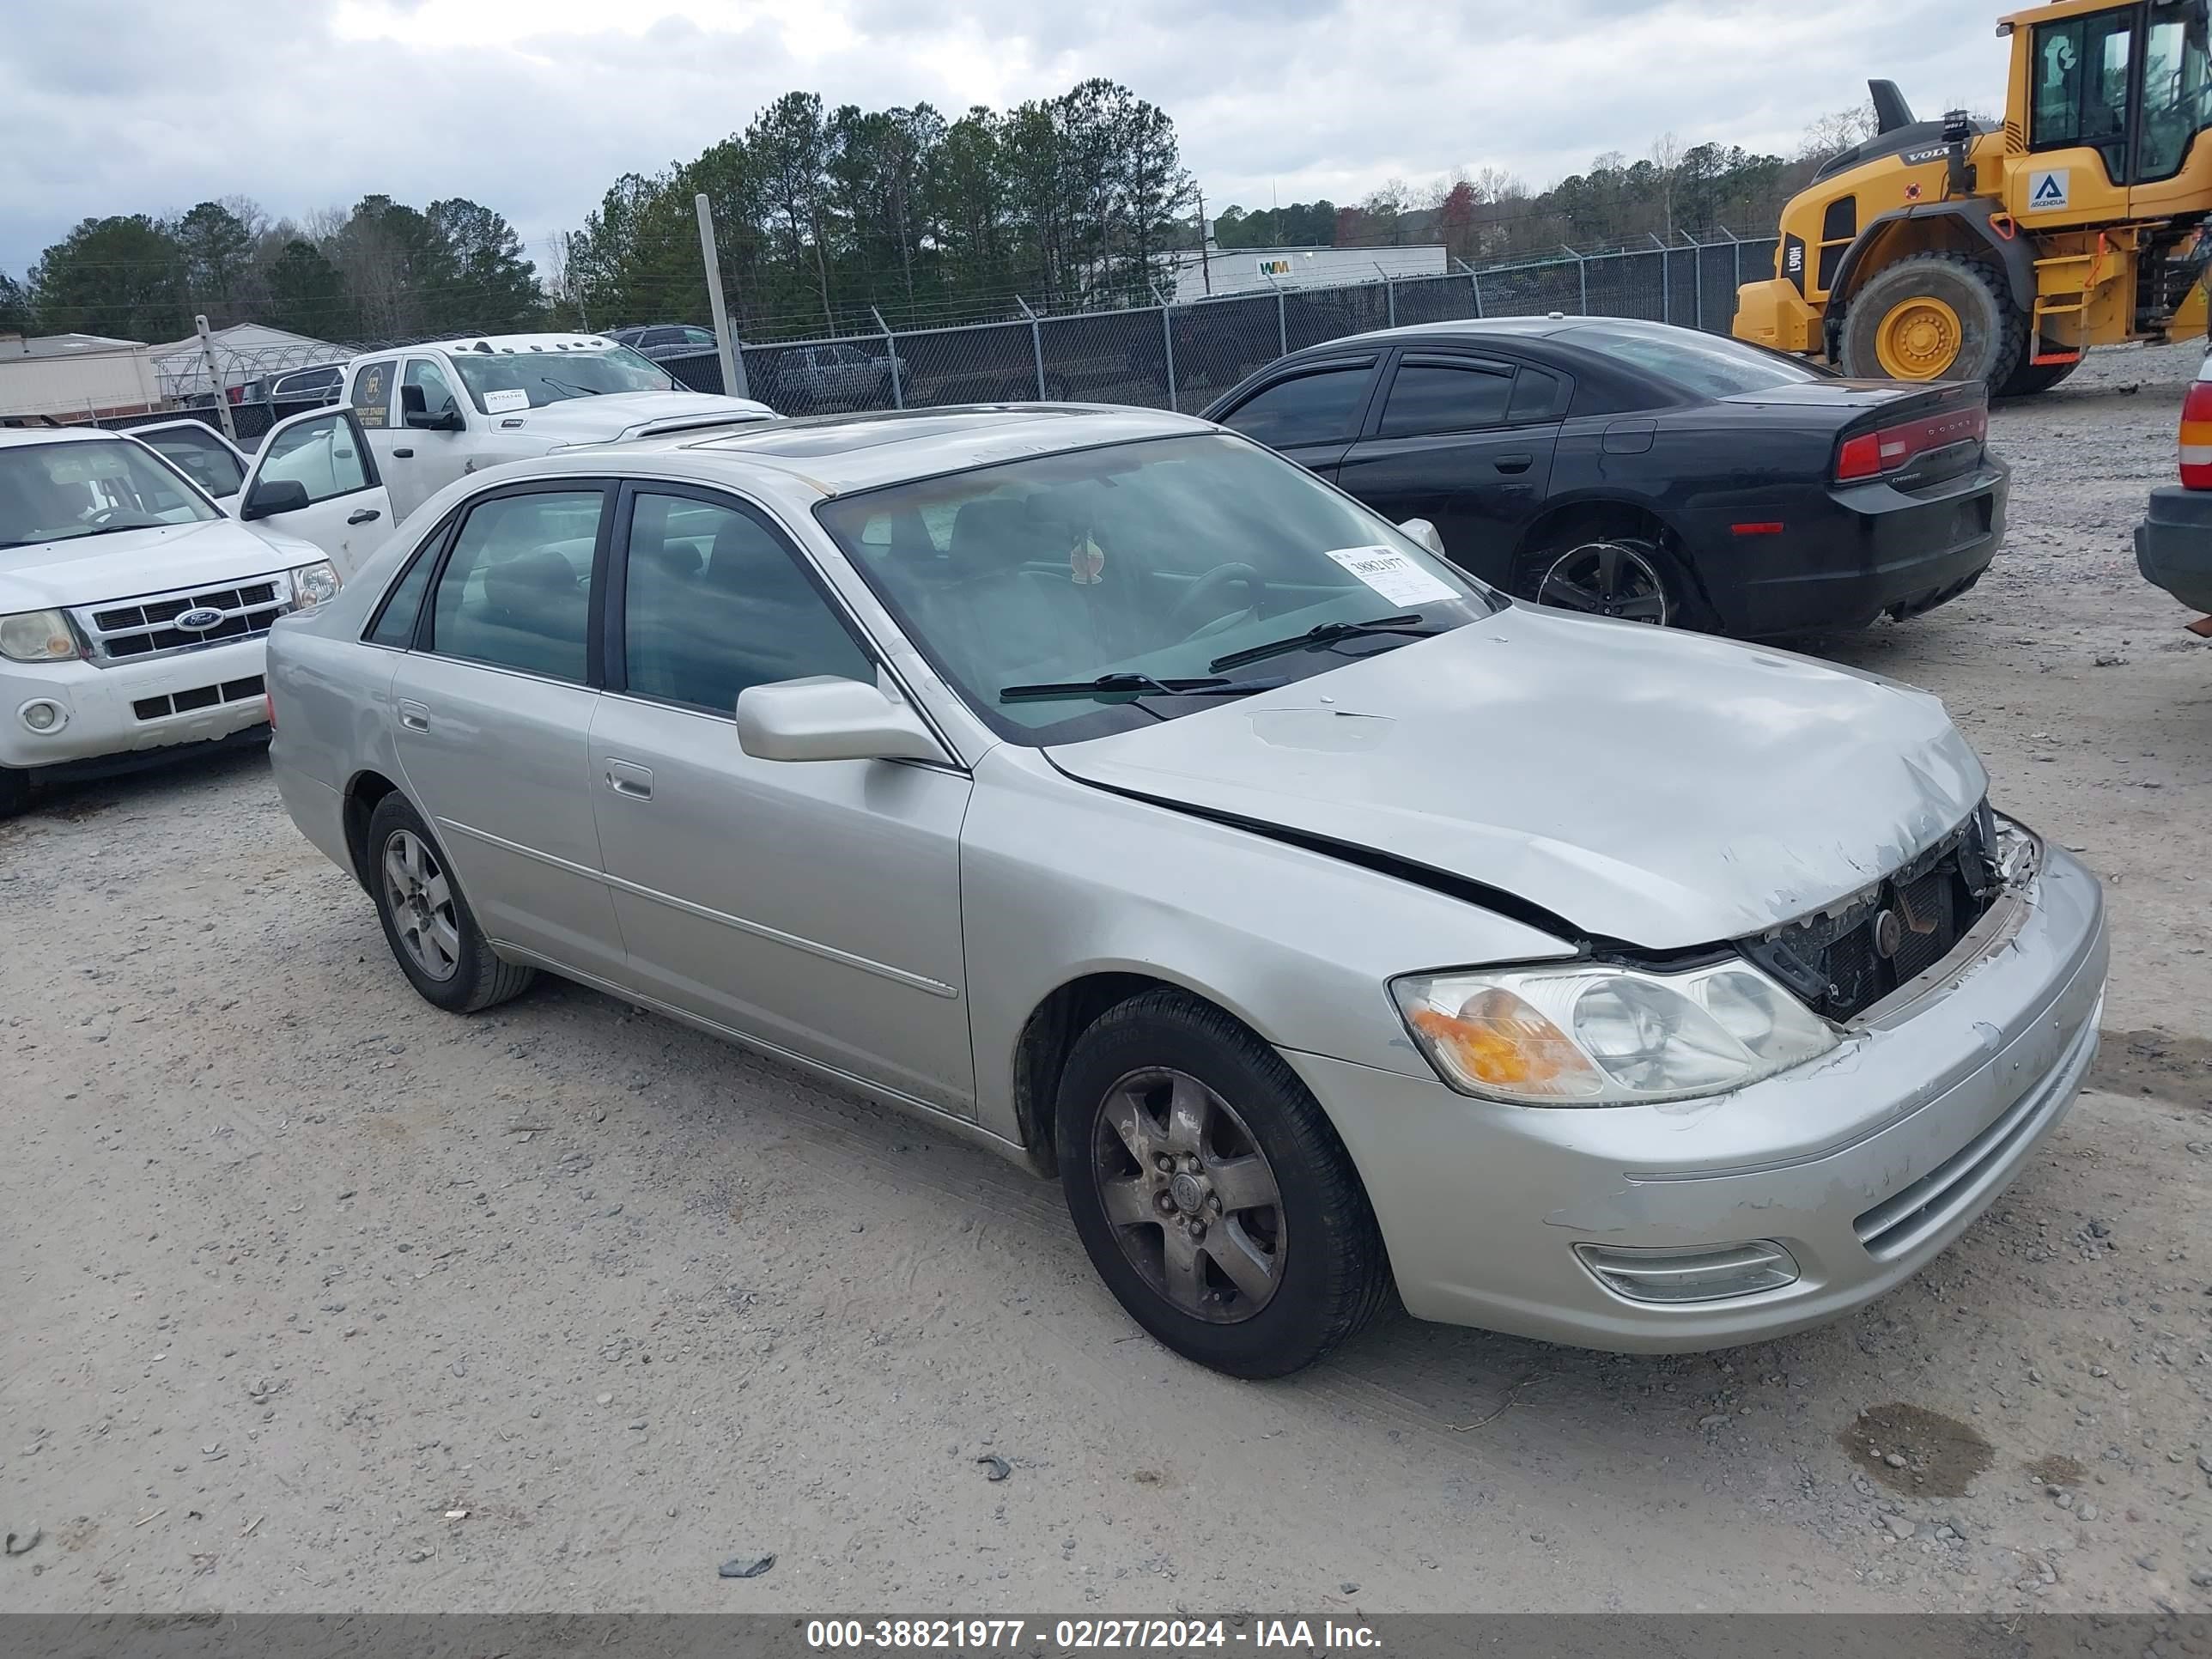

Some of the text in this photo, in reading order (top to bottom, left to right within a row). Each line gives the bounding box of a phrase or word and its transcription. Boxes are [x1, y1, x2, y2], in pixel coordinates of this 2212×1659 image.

[2030, 199, 2067, 208] ASCENDUM
[1789, 246, 1802, 272] L90H
[1260, 260, 1290, 275] WM
[1350, 557, 1409, 574] 38821977
